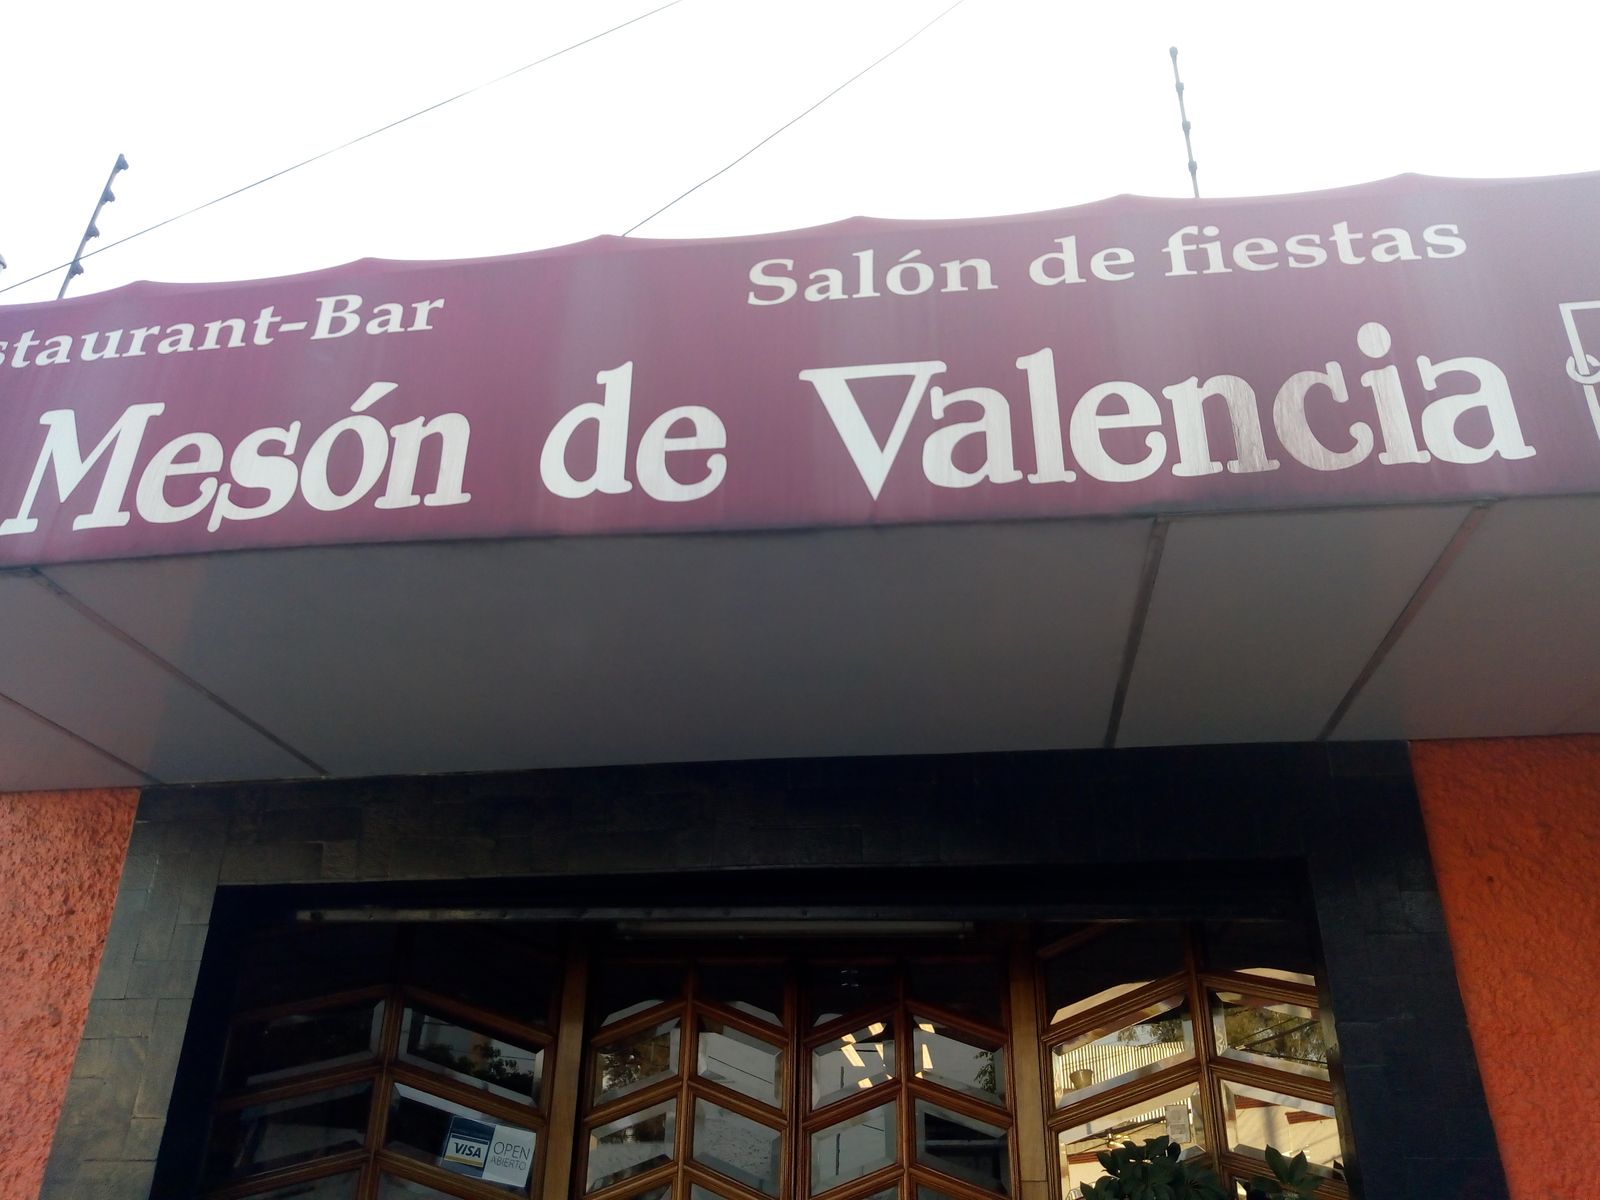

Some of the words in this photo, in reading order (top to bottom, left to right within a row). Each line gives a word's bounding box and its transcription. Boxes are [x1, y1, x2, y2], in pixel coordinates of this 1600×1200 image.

[747, 249, 999, 307] Salón
[1029, 235, 1136, 286] de
[1162, 220, 1468, 277] fiestas
[0, 381, 471, 536] Mesón
[540, 361, 728, 502] de
[799, 321, 1537, 500] Valencia
[454, 1141, 482, 1159] VISA
[493, 1141, 531, 1160] OPEN
[490, 1156, 527, 1171] ABIERTO
